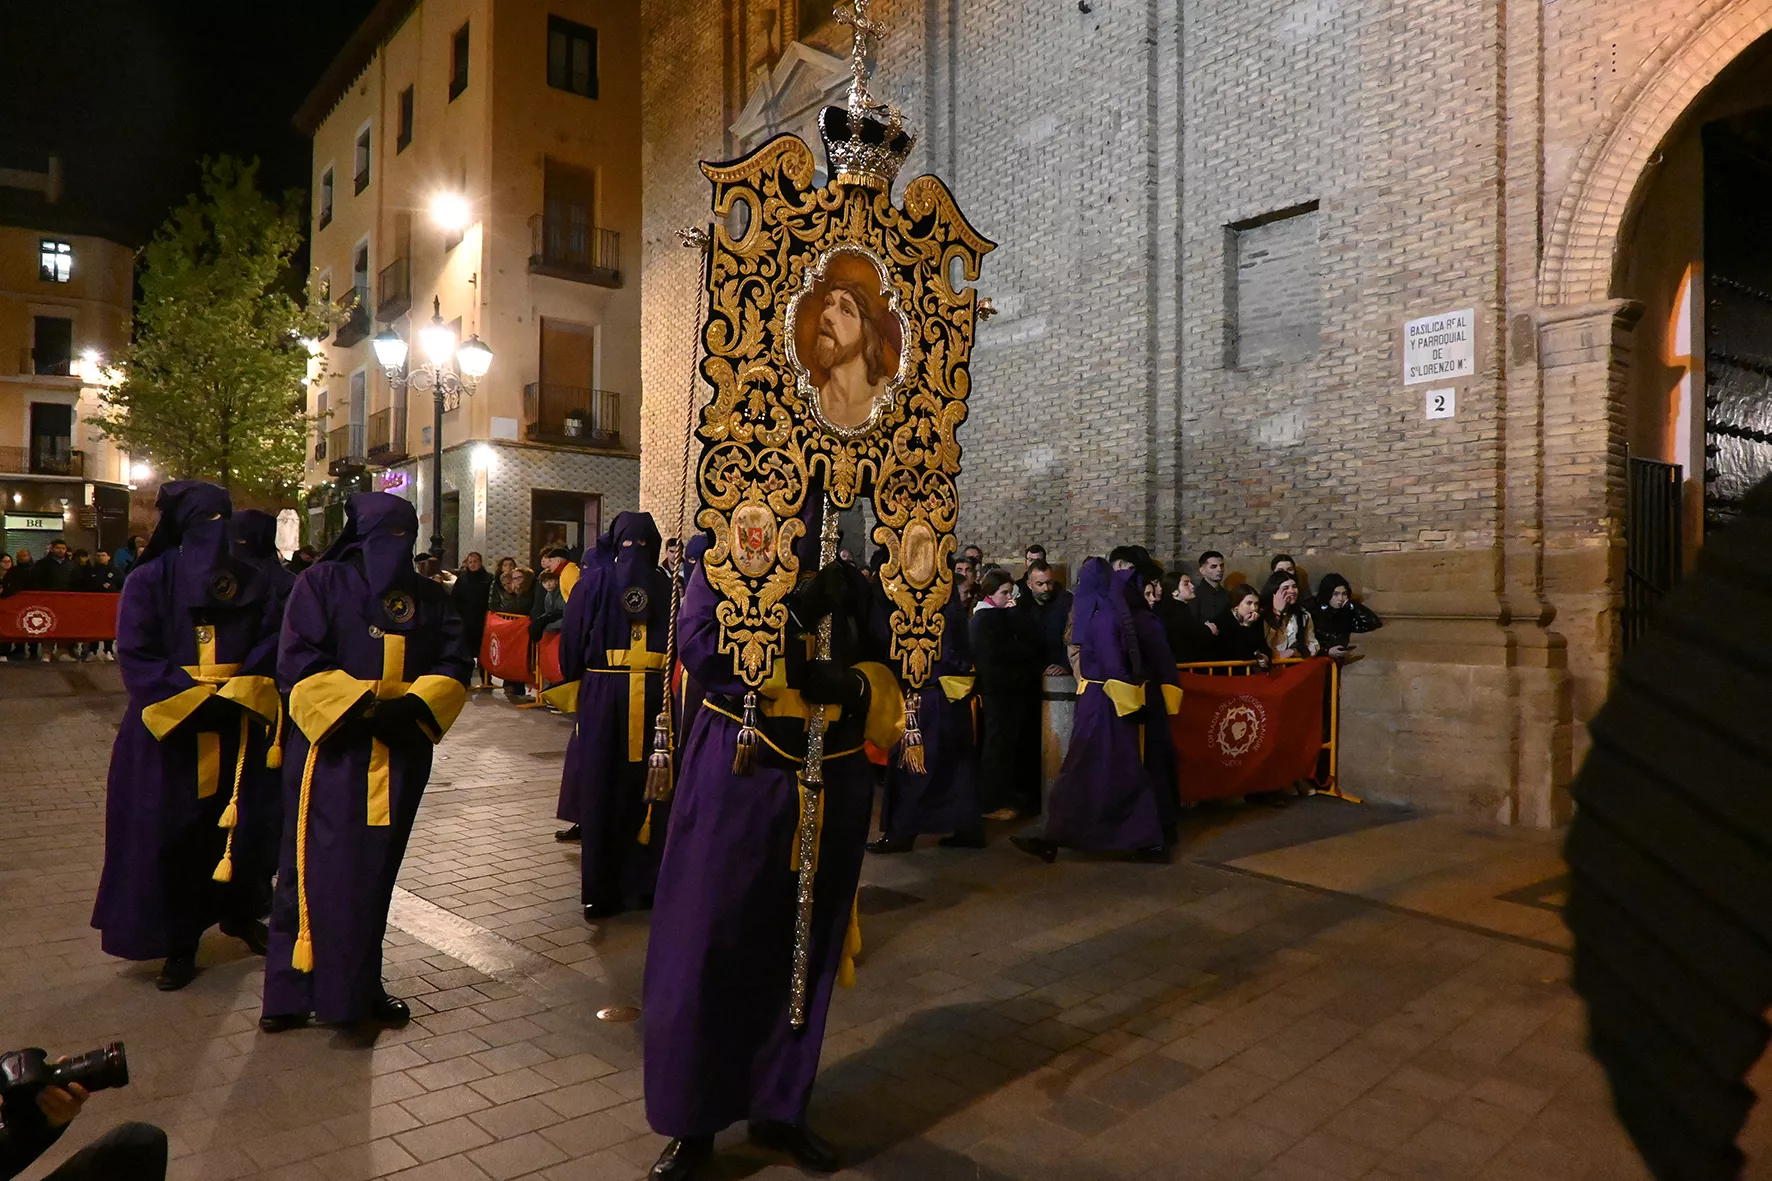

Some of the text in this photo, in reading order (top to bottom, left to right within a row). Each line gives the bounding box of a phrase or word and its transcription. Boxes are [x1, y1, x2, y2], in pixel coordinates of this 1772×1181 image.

[1410, 321, 1444, 336] BASILICA
[1410, 331, 1466, 350] Y PARROQUIAL
[1432, 348, 1443, 360] DE
[1418, 360, 1454, 376] LORENZO
[1434, 395, 1445, 412] 2
